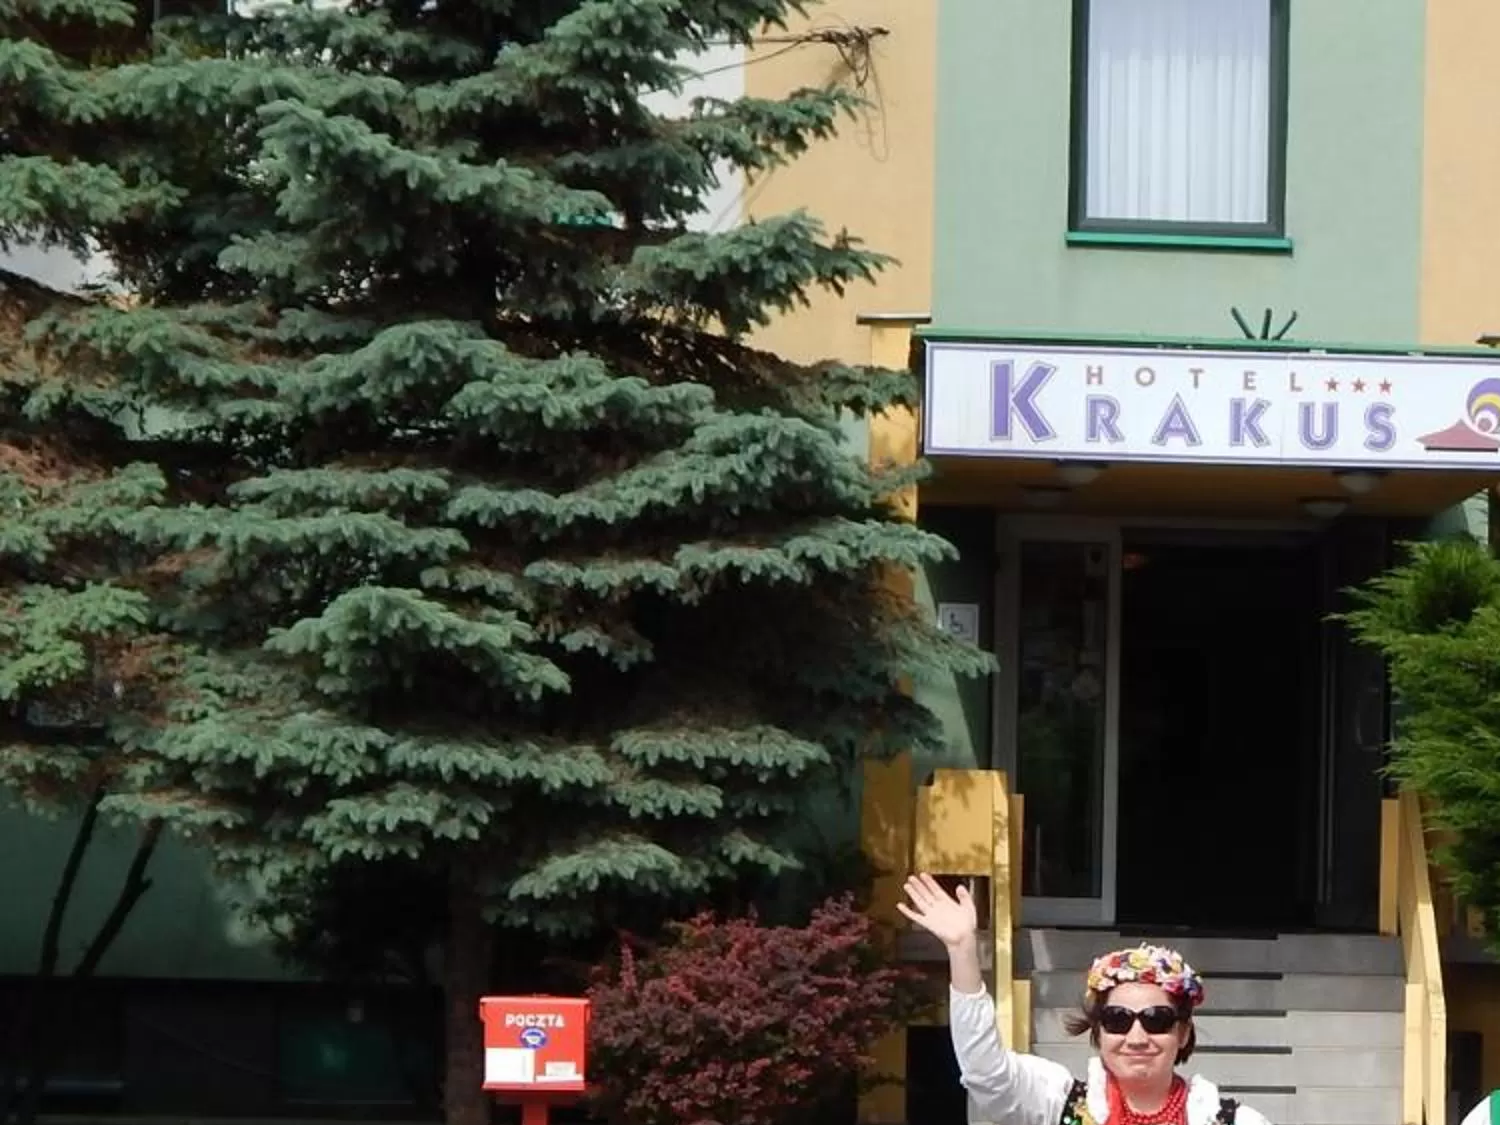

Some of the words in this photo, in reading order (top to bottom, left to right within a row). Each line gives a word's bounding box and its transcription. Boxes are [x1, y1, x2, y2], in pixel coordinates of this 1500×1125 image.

[1085, 364, 1304, 393] HOTEL
[988, 359, 1398, 451] KRAKUS
[505, 1013, 565, 1028] POCZTA
